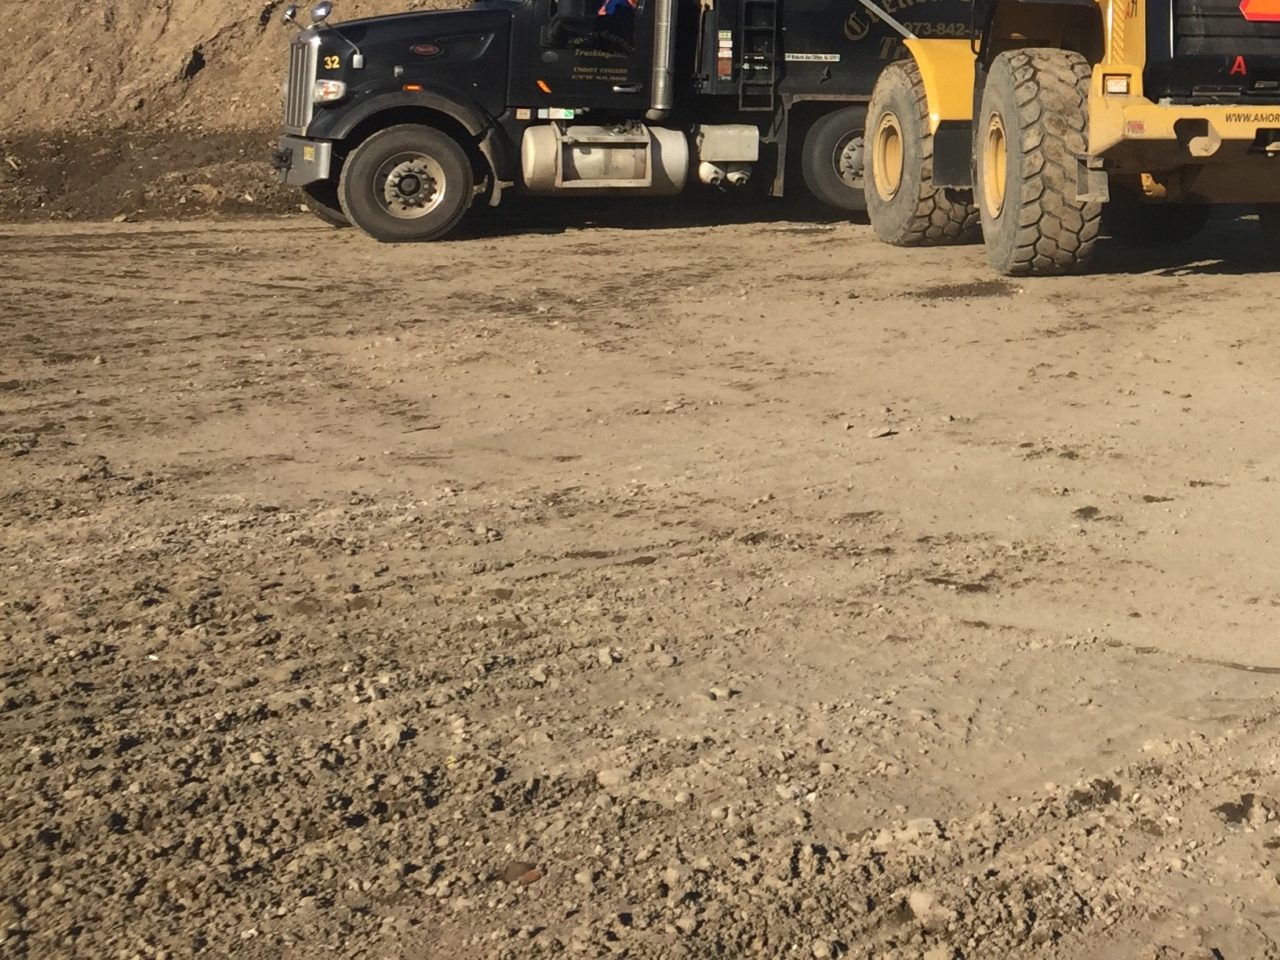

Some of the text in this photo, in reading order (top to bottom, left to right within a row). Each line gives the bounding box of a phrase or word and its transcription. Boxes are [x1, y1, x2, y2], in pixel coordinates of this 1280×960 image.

[903, 22, 981, 37] 973-842-
[323, 55, 341, 70] 32
[1229, 55, 1247, 76] A
